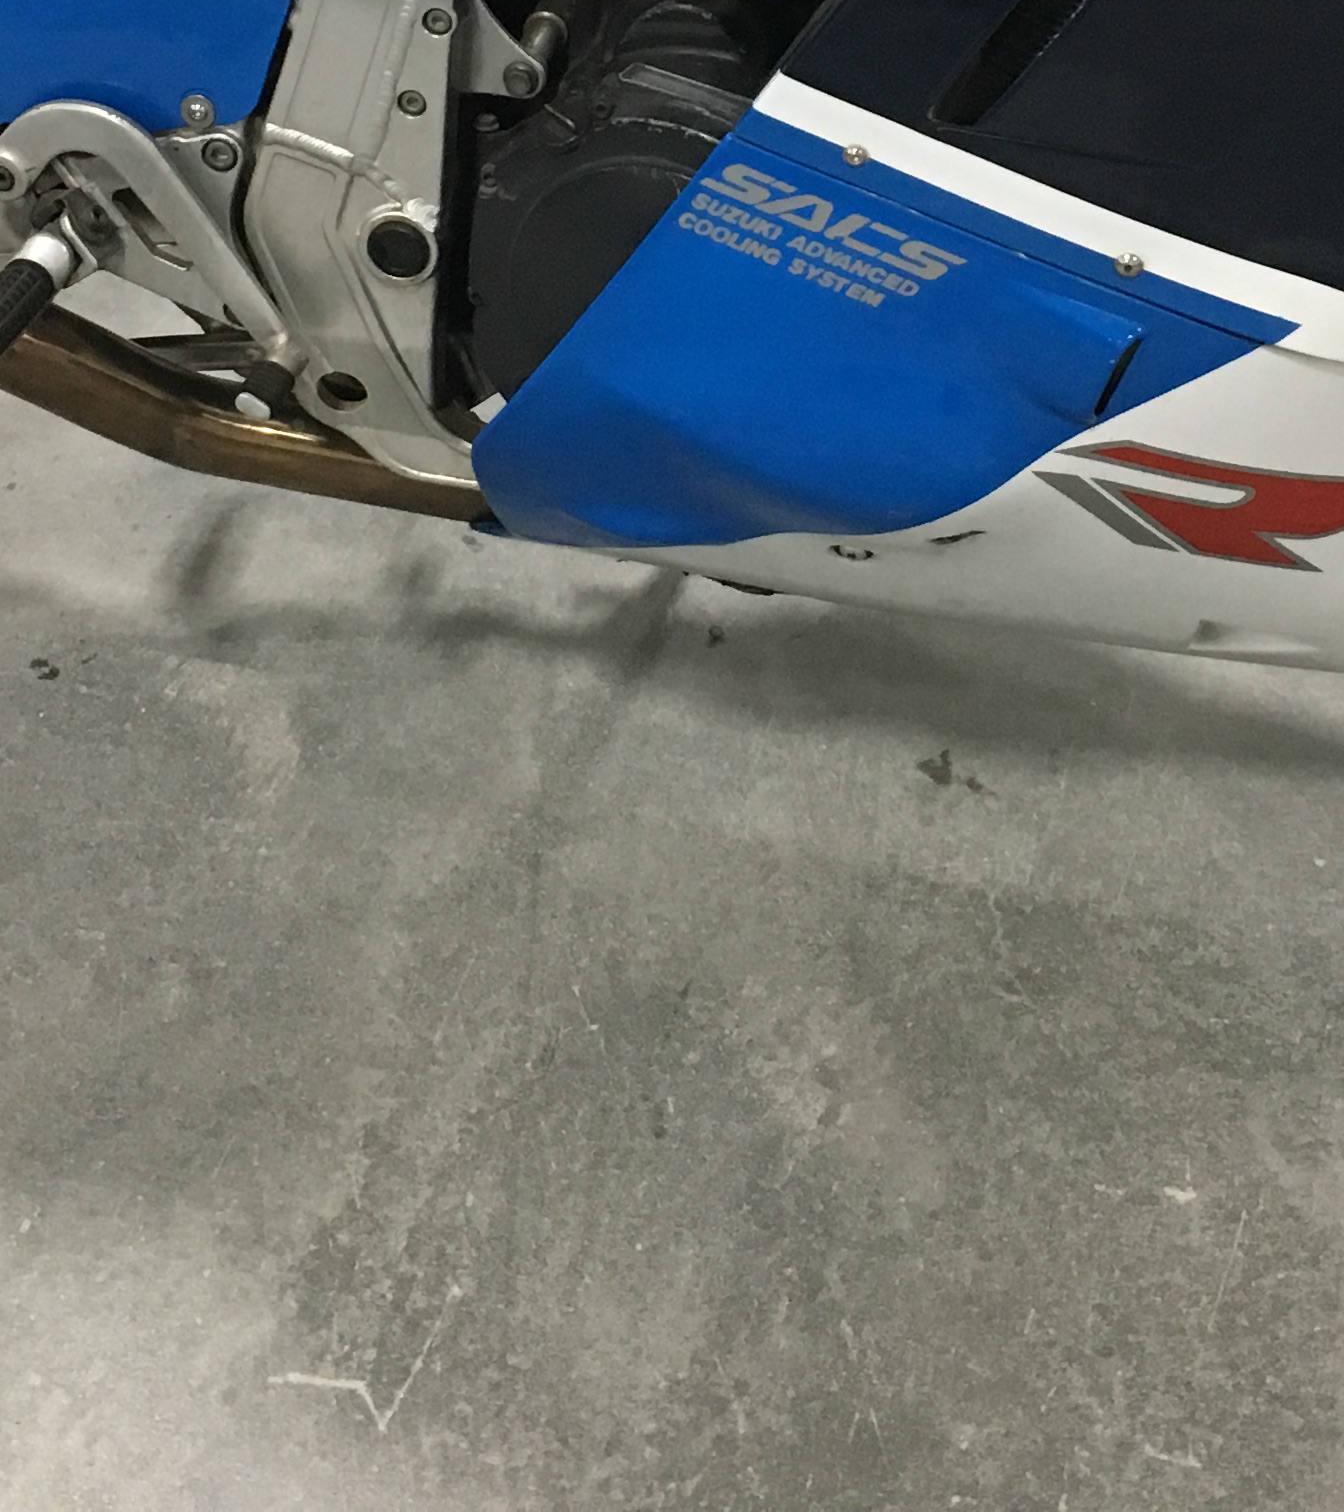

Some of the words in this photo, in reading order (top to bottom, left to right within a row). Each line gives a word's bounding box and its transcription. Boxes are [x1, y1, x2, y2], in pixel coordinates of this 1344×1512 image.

[677, 211, 783, 266] COOLING
[787, 257, 886, 308] SYSTEM
[690, 192, 783, 240] SUZUKI
[786, 235, 921, 297] ADVANCED
[699, 163, 968, 282] SACS
